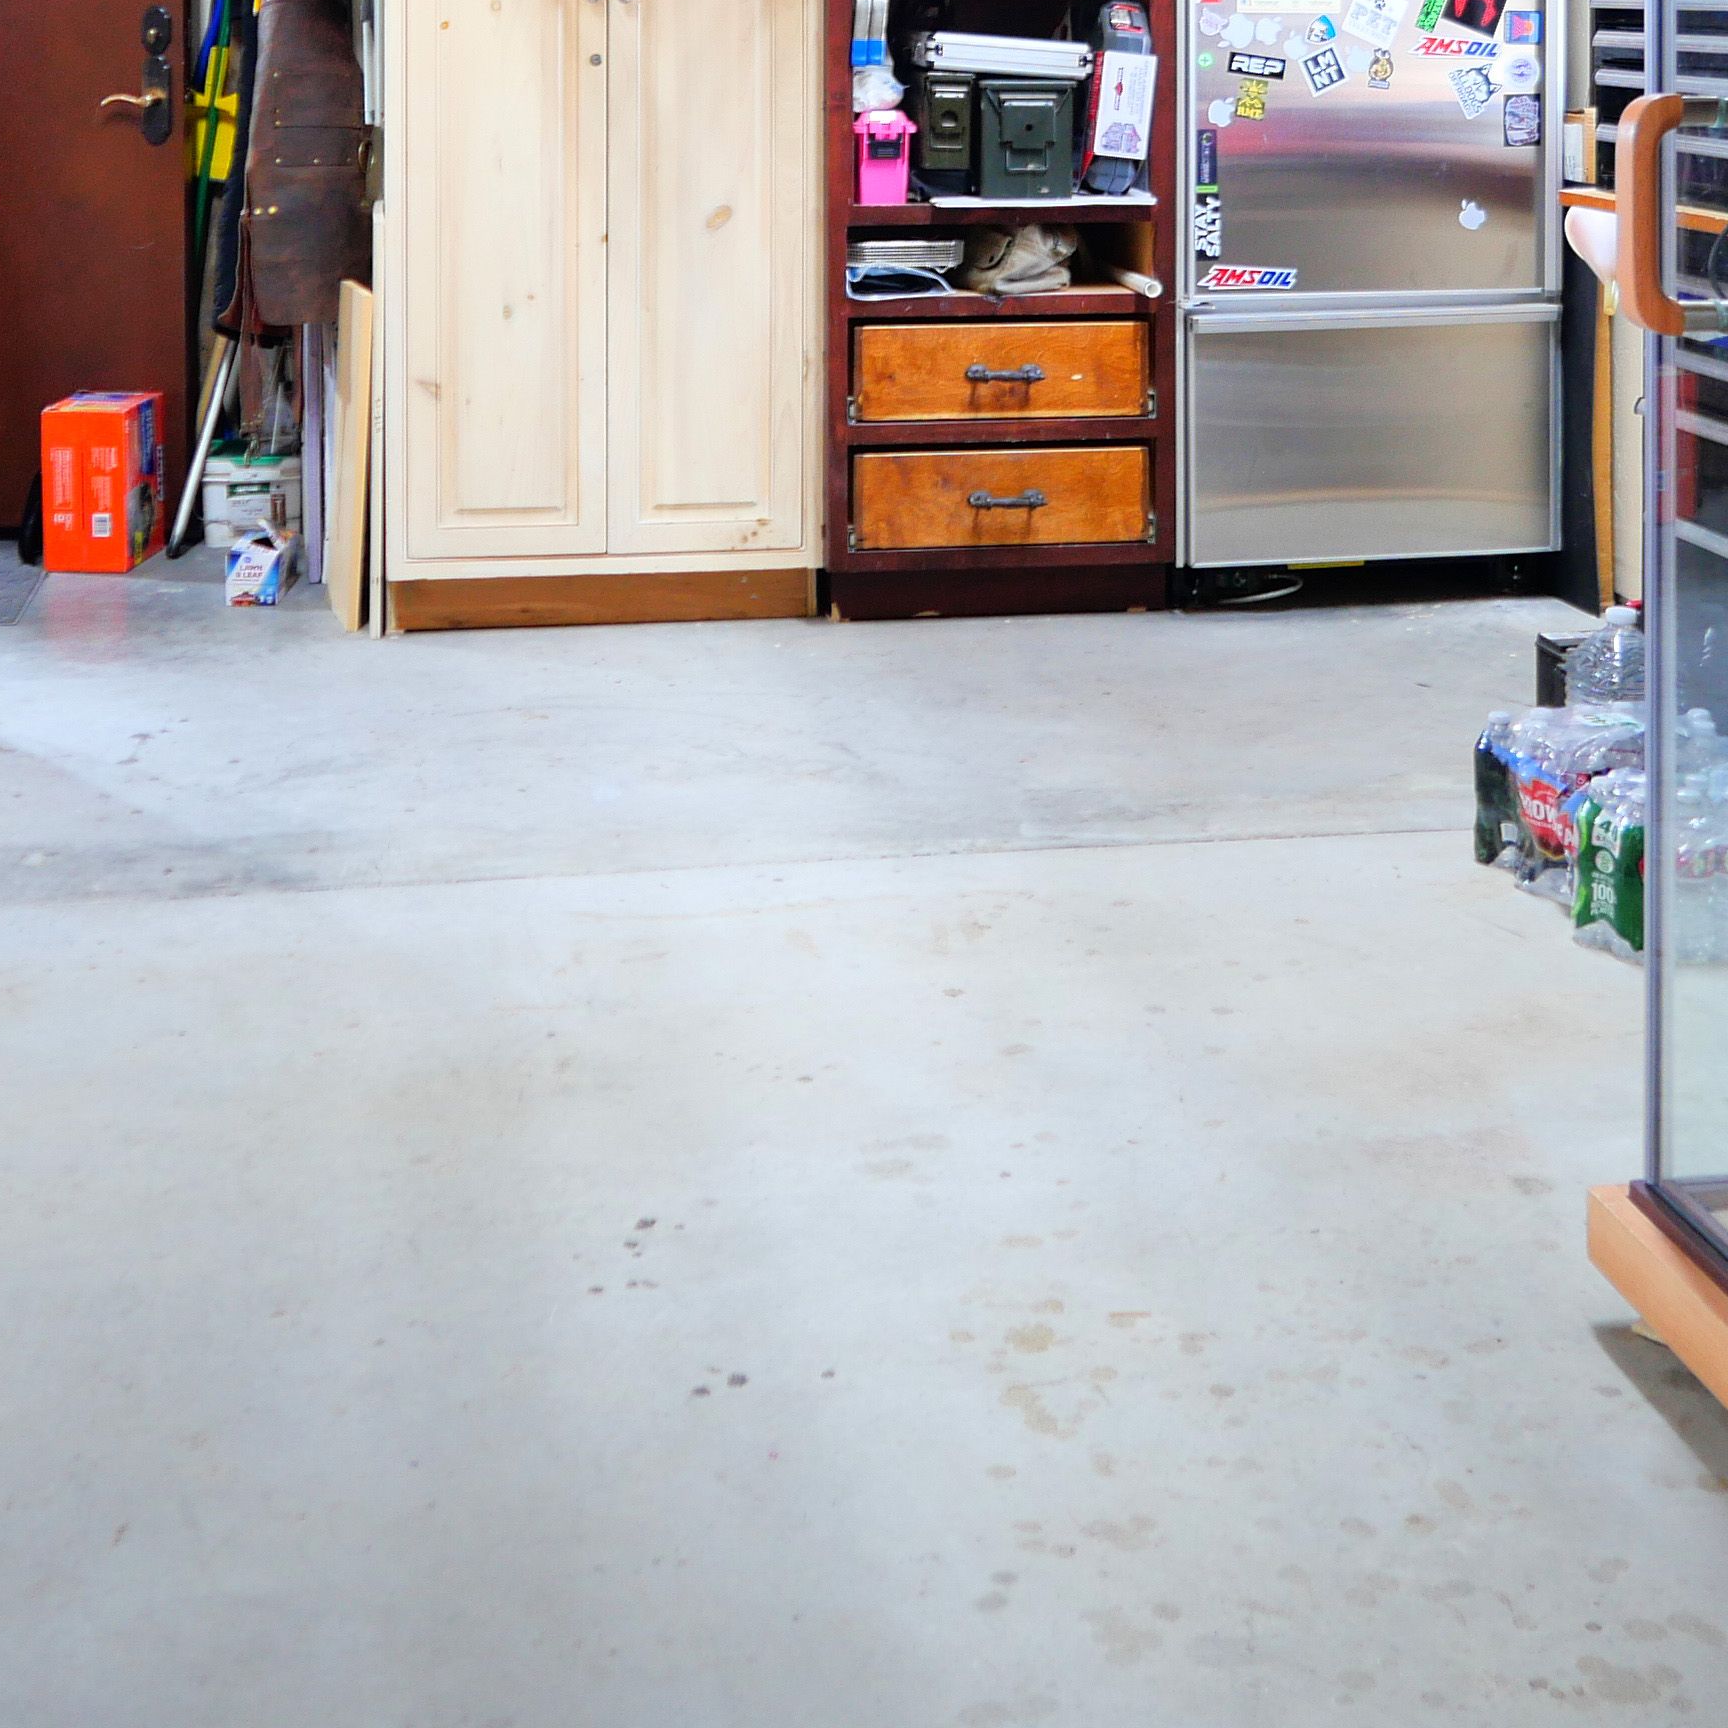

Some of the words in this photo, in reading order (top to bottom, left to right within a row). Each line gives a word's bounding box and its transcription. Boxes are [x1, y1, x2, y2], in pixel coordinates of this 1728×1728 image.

[1415, 37, 1499, 57] AMSOIL
[1194, 203, 1208, 252] STAY
[1206, 196, 1222, 258] SALTY
[1206, 268, 1295, 287] AMSOIL
